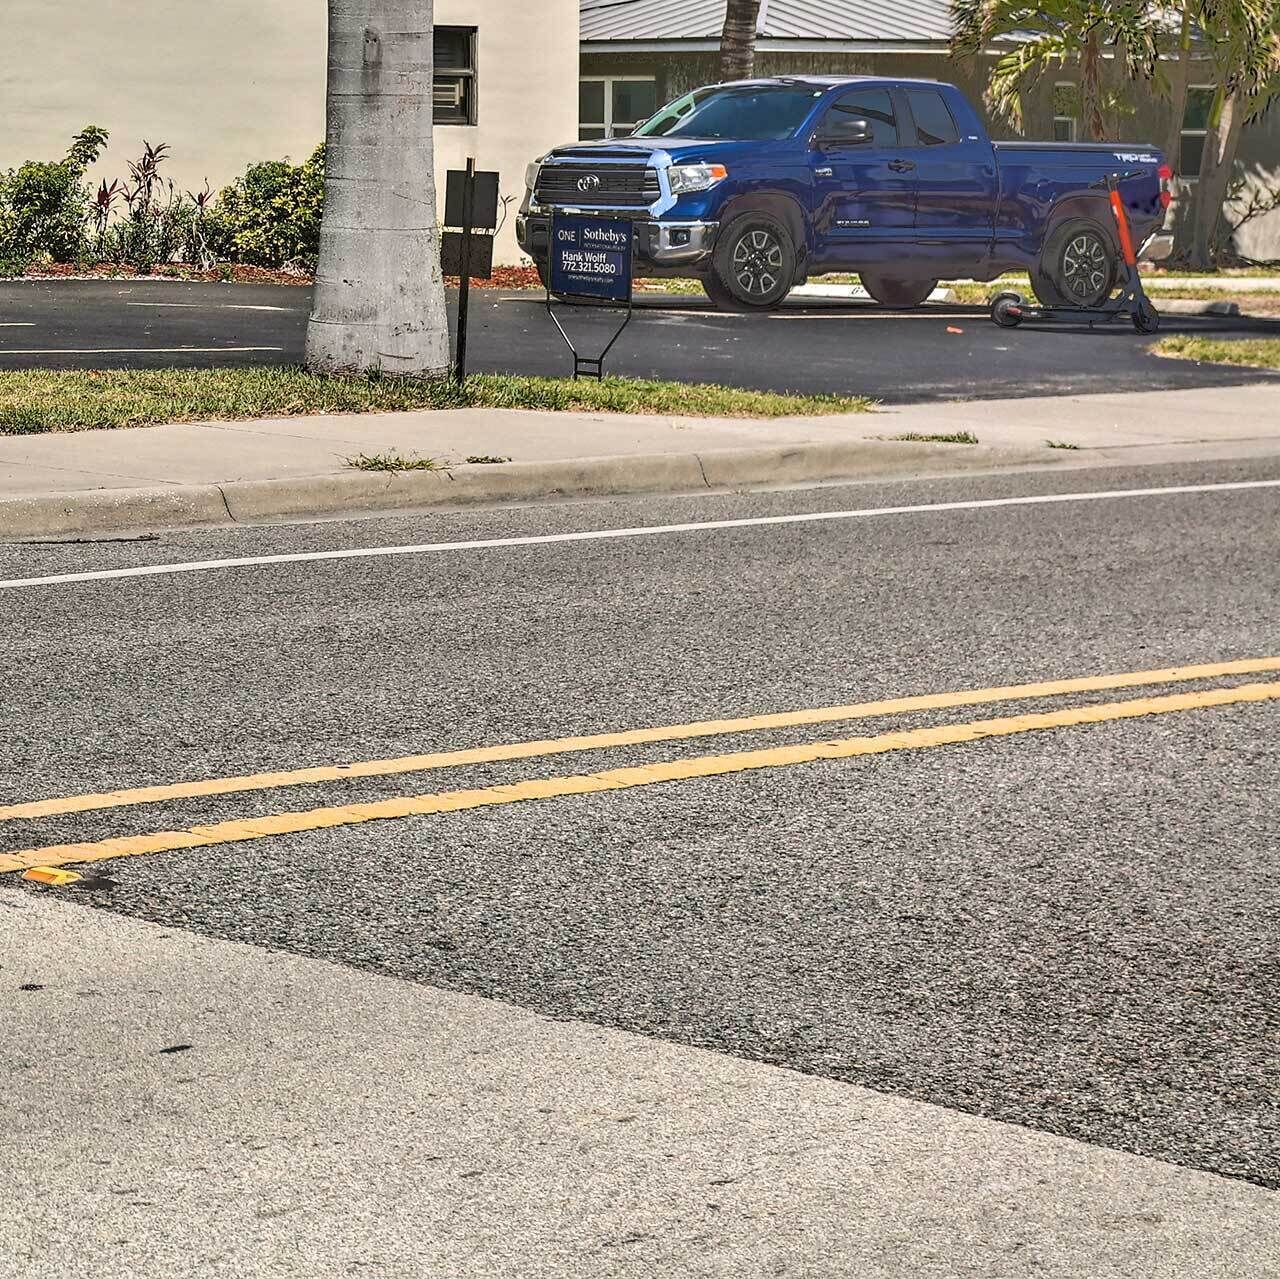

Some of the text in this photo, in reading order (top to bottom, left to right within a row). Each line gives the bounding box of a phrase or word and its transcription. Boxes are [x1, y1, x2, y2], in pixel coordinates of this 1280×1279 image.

[558, 227, 627, 245] ONE Sotheby's
[562, 250, 607, 263] Hank Wolff
[562, 261, 616, 274] 772.321.5080
